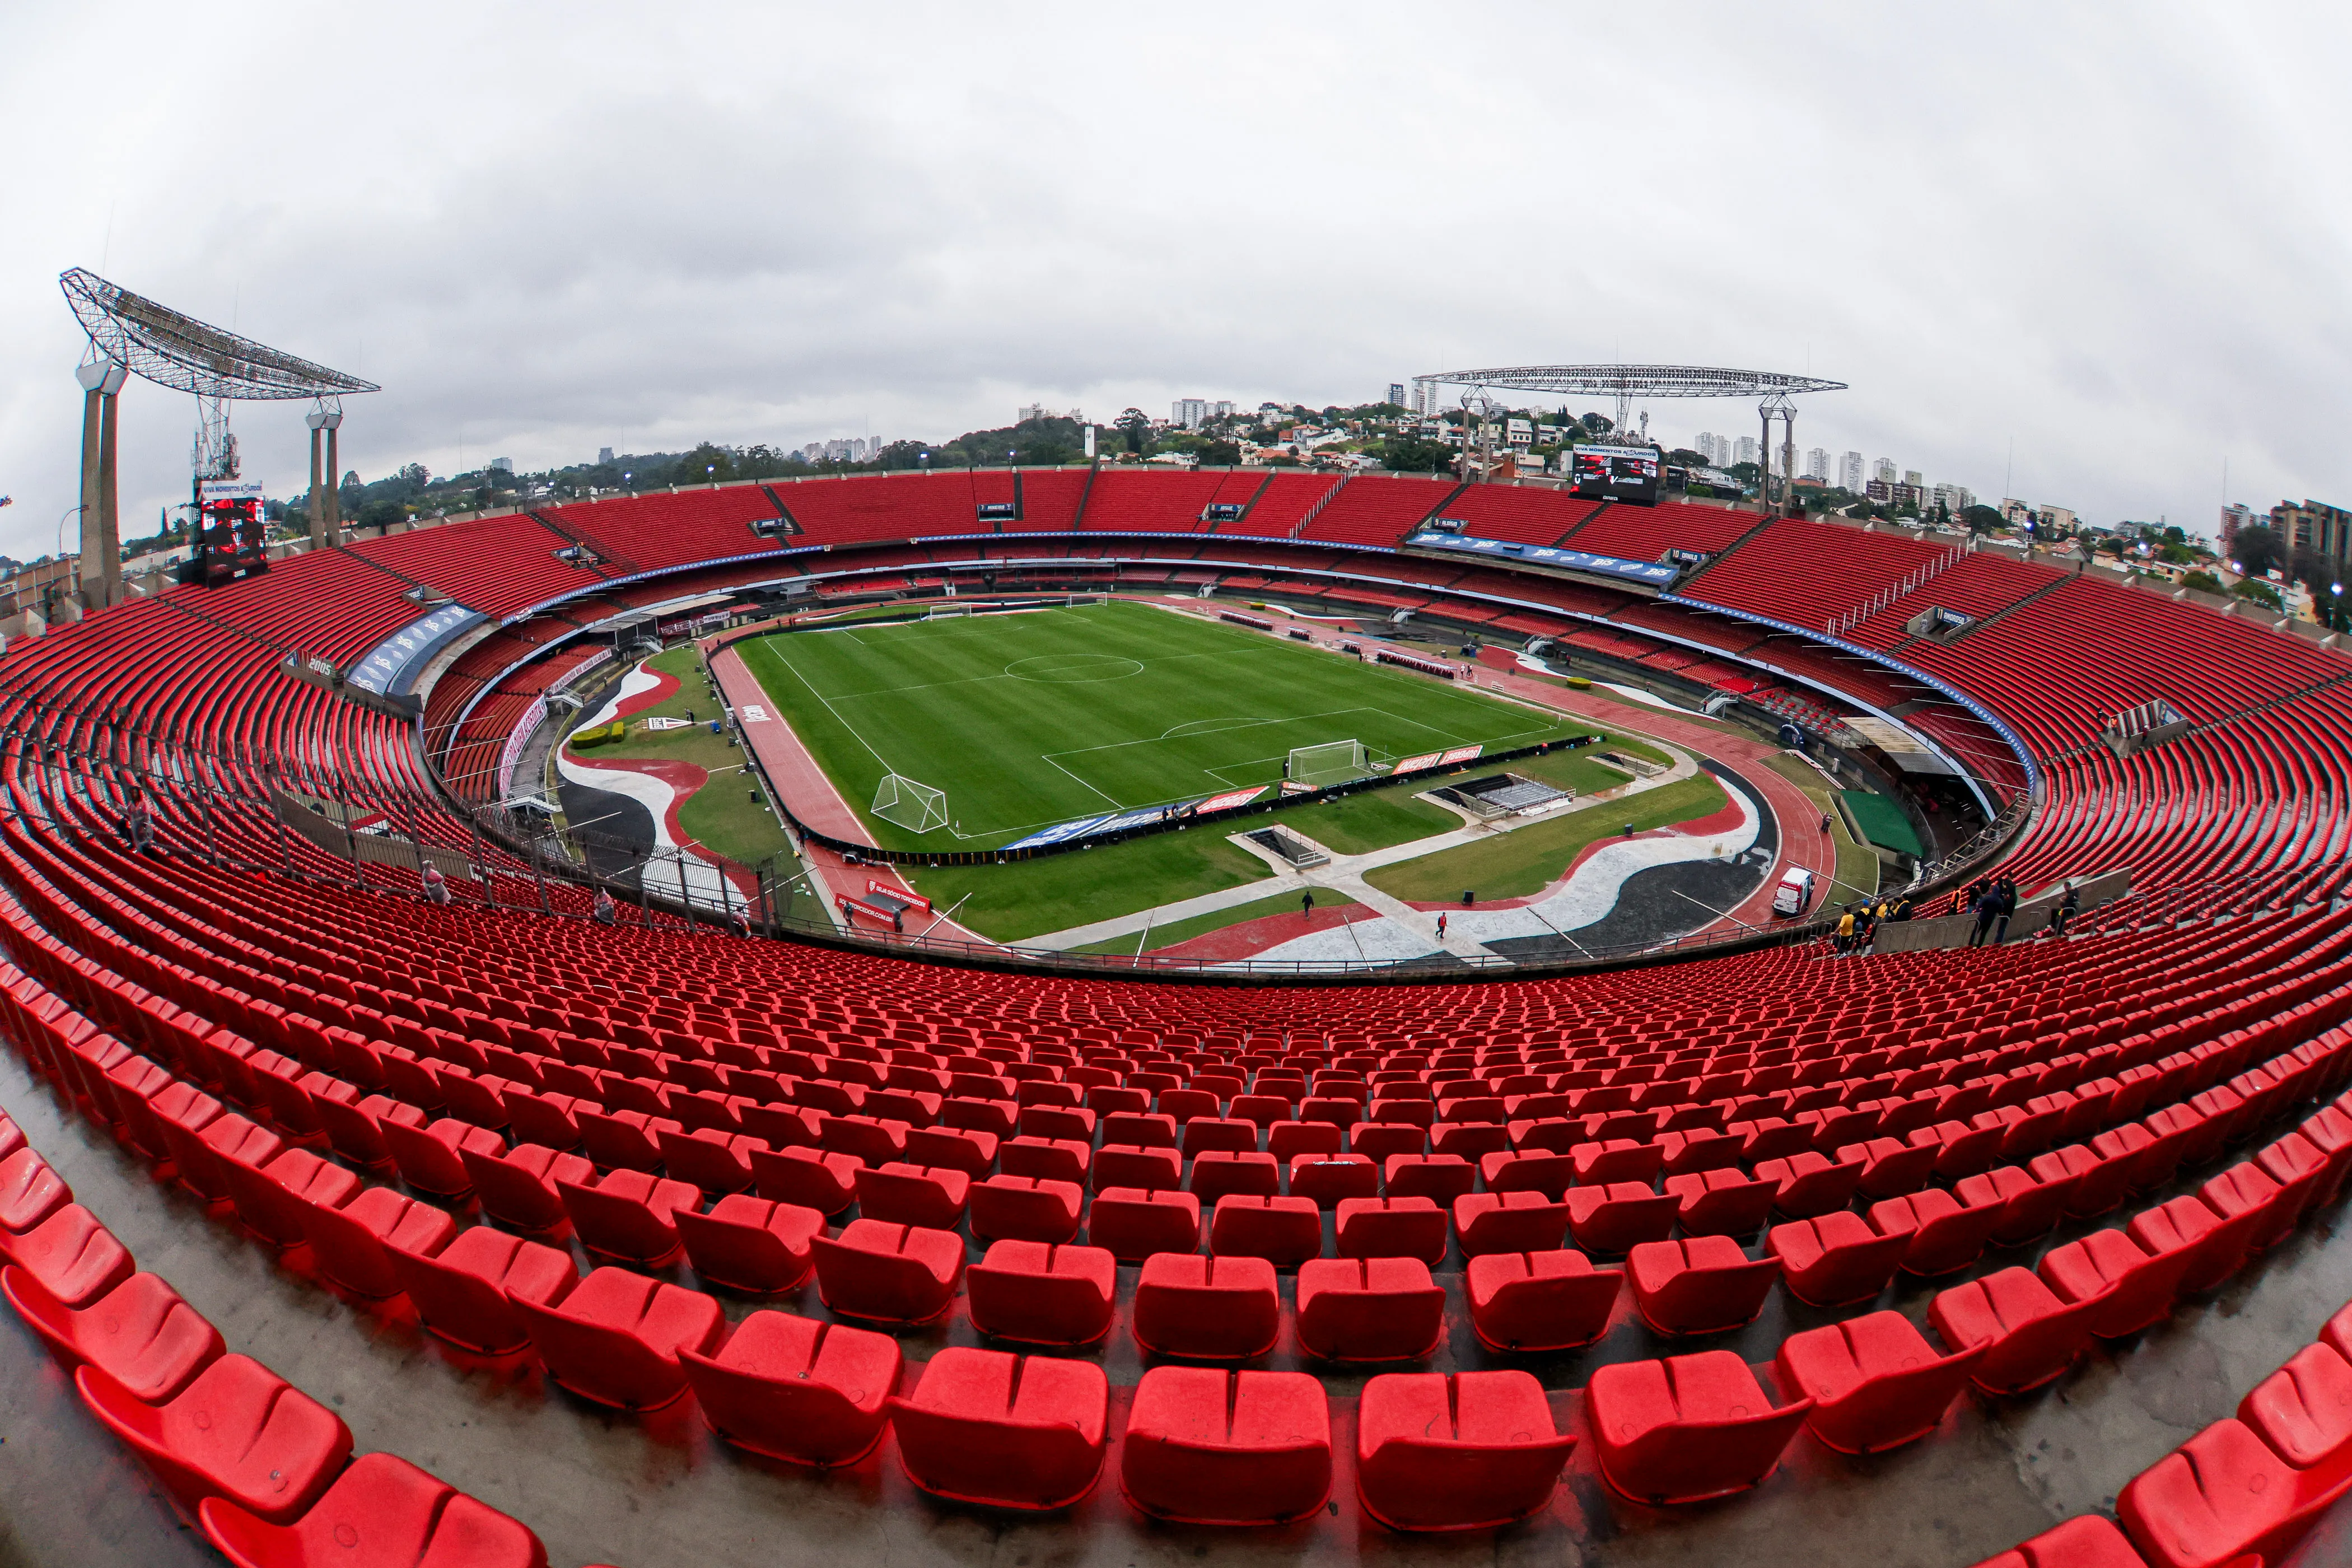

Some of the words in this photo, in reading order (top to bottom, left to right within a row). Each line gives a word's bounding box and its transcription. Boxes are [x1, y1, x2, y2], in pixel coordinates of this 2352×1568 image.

[1673, 549, 1679, 558] 10
[1682, 552, 1698, 561] DANILO
[1937, 608, 1943, 619] 11
[1944, 612, 1964, 624] AMOROSO
[309, 657, 332, 676] 2005
[1439, 748, 1480, 765] SUPERBET
[887, 890, 900, 898] SÓCIO
[900, 895, 926, 908] TORCEDOR!
